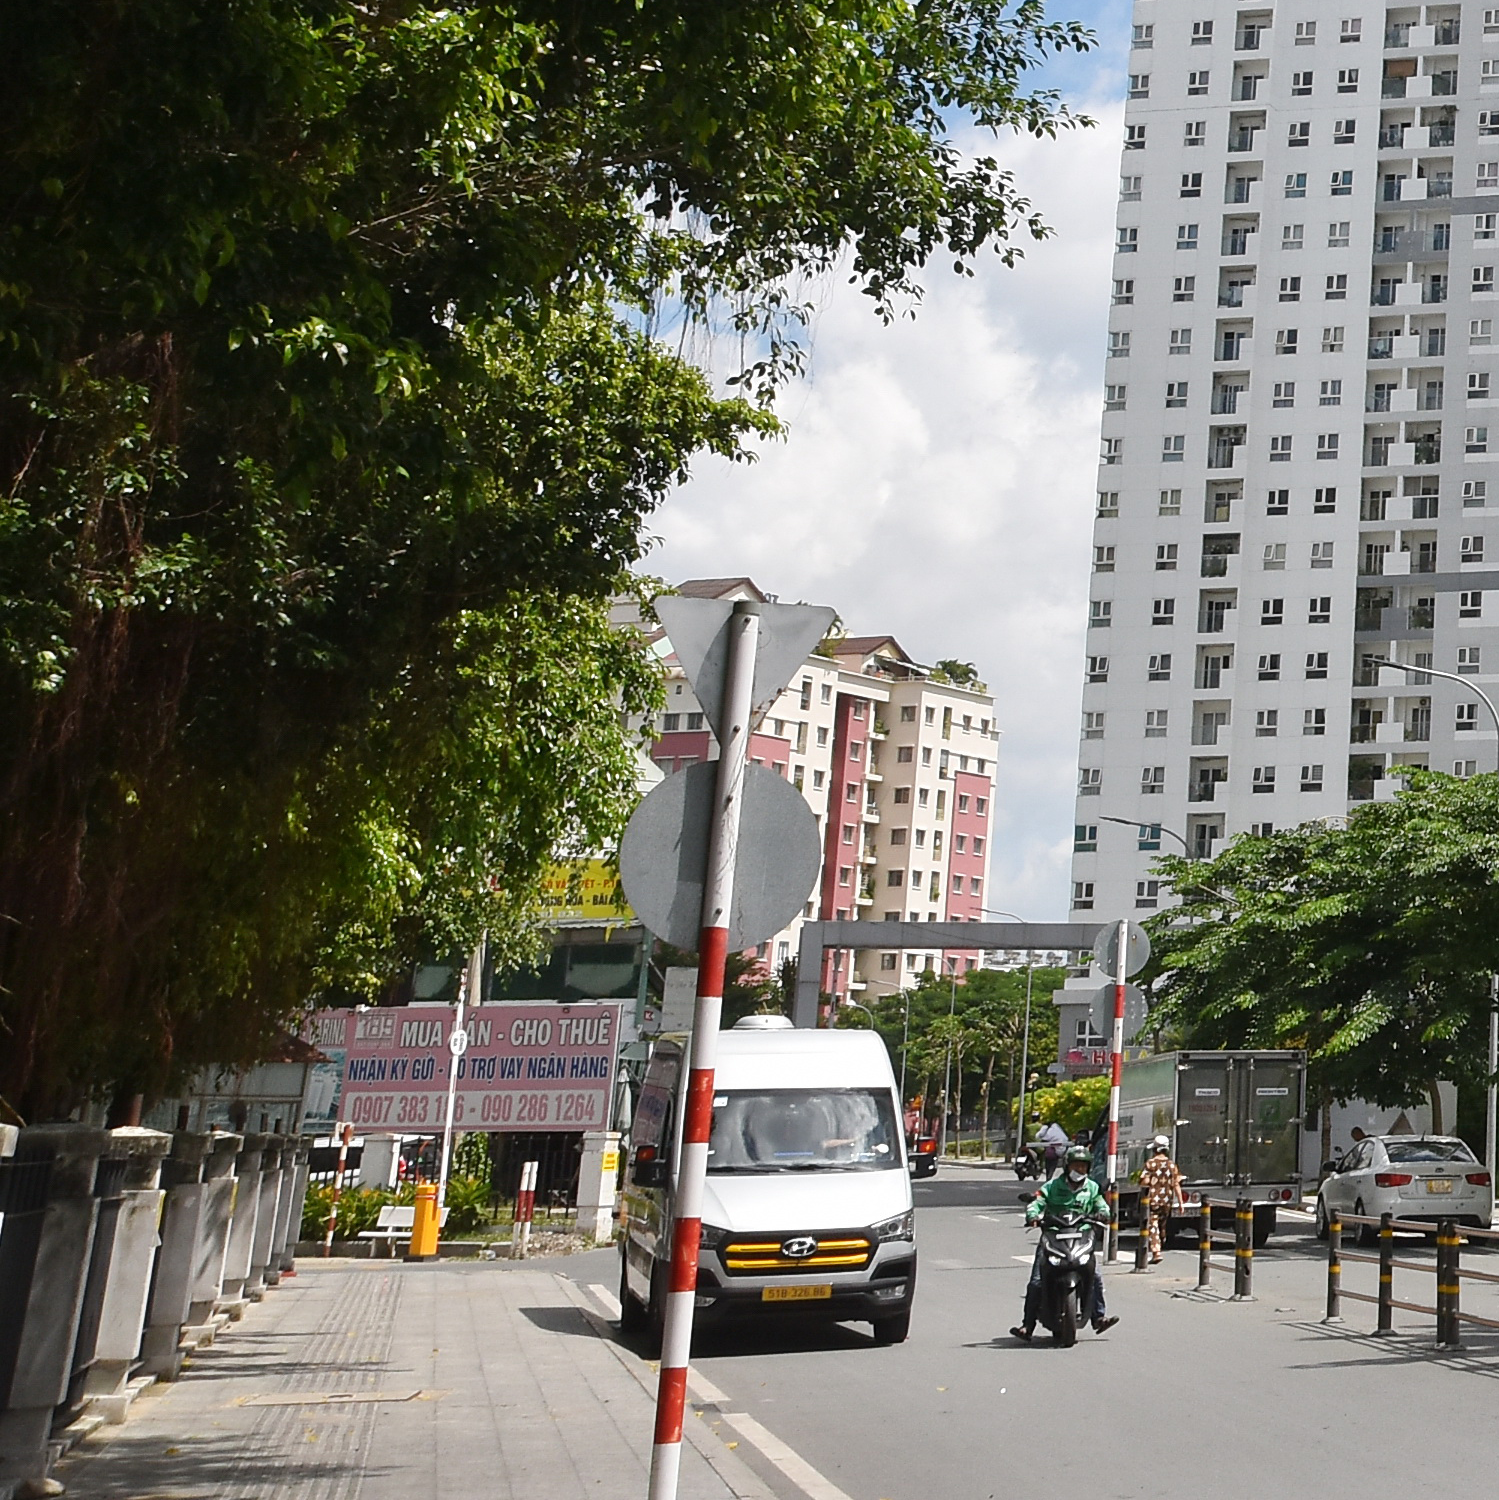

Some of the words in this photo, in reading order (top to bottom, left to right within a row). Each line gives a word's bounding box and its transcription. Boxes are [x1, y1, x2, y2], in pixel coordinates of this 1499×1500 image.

[400, 1020, 443, 1048] MUA
[449, 1012, 492, 1047] ÁN
[510, 1018, 552, 1047] CHO
[558, 1011, 612, 1046] THUÊ
[349, 1054, 388, 1087] NHẬN
[390, 1053, 409, 1081] KÝ
[411, 1051, 435, 1081] GỬI
[470, 1055, 498, 1085] TRỢ
[500, 1057, 524, 1080] VAY
[526, 1053, 567, 1080] NGÂN
[569, 1052, 609, 1079] HÀNG
[351, 1095, 394, 1123] 0907
[398, 1094, 430, 1123] 383
[481, 1094, 513, 1123] 090
[516, 1093, 548, 1122] 286
[555, 1093, 595, 1122] 1264
